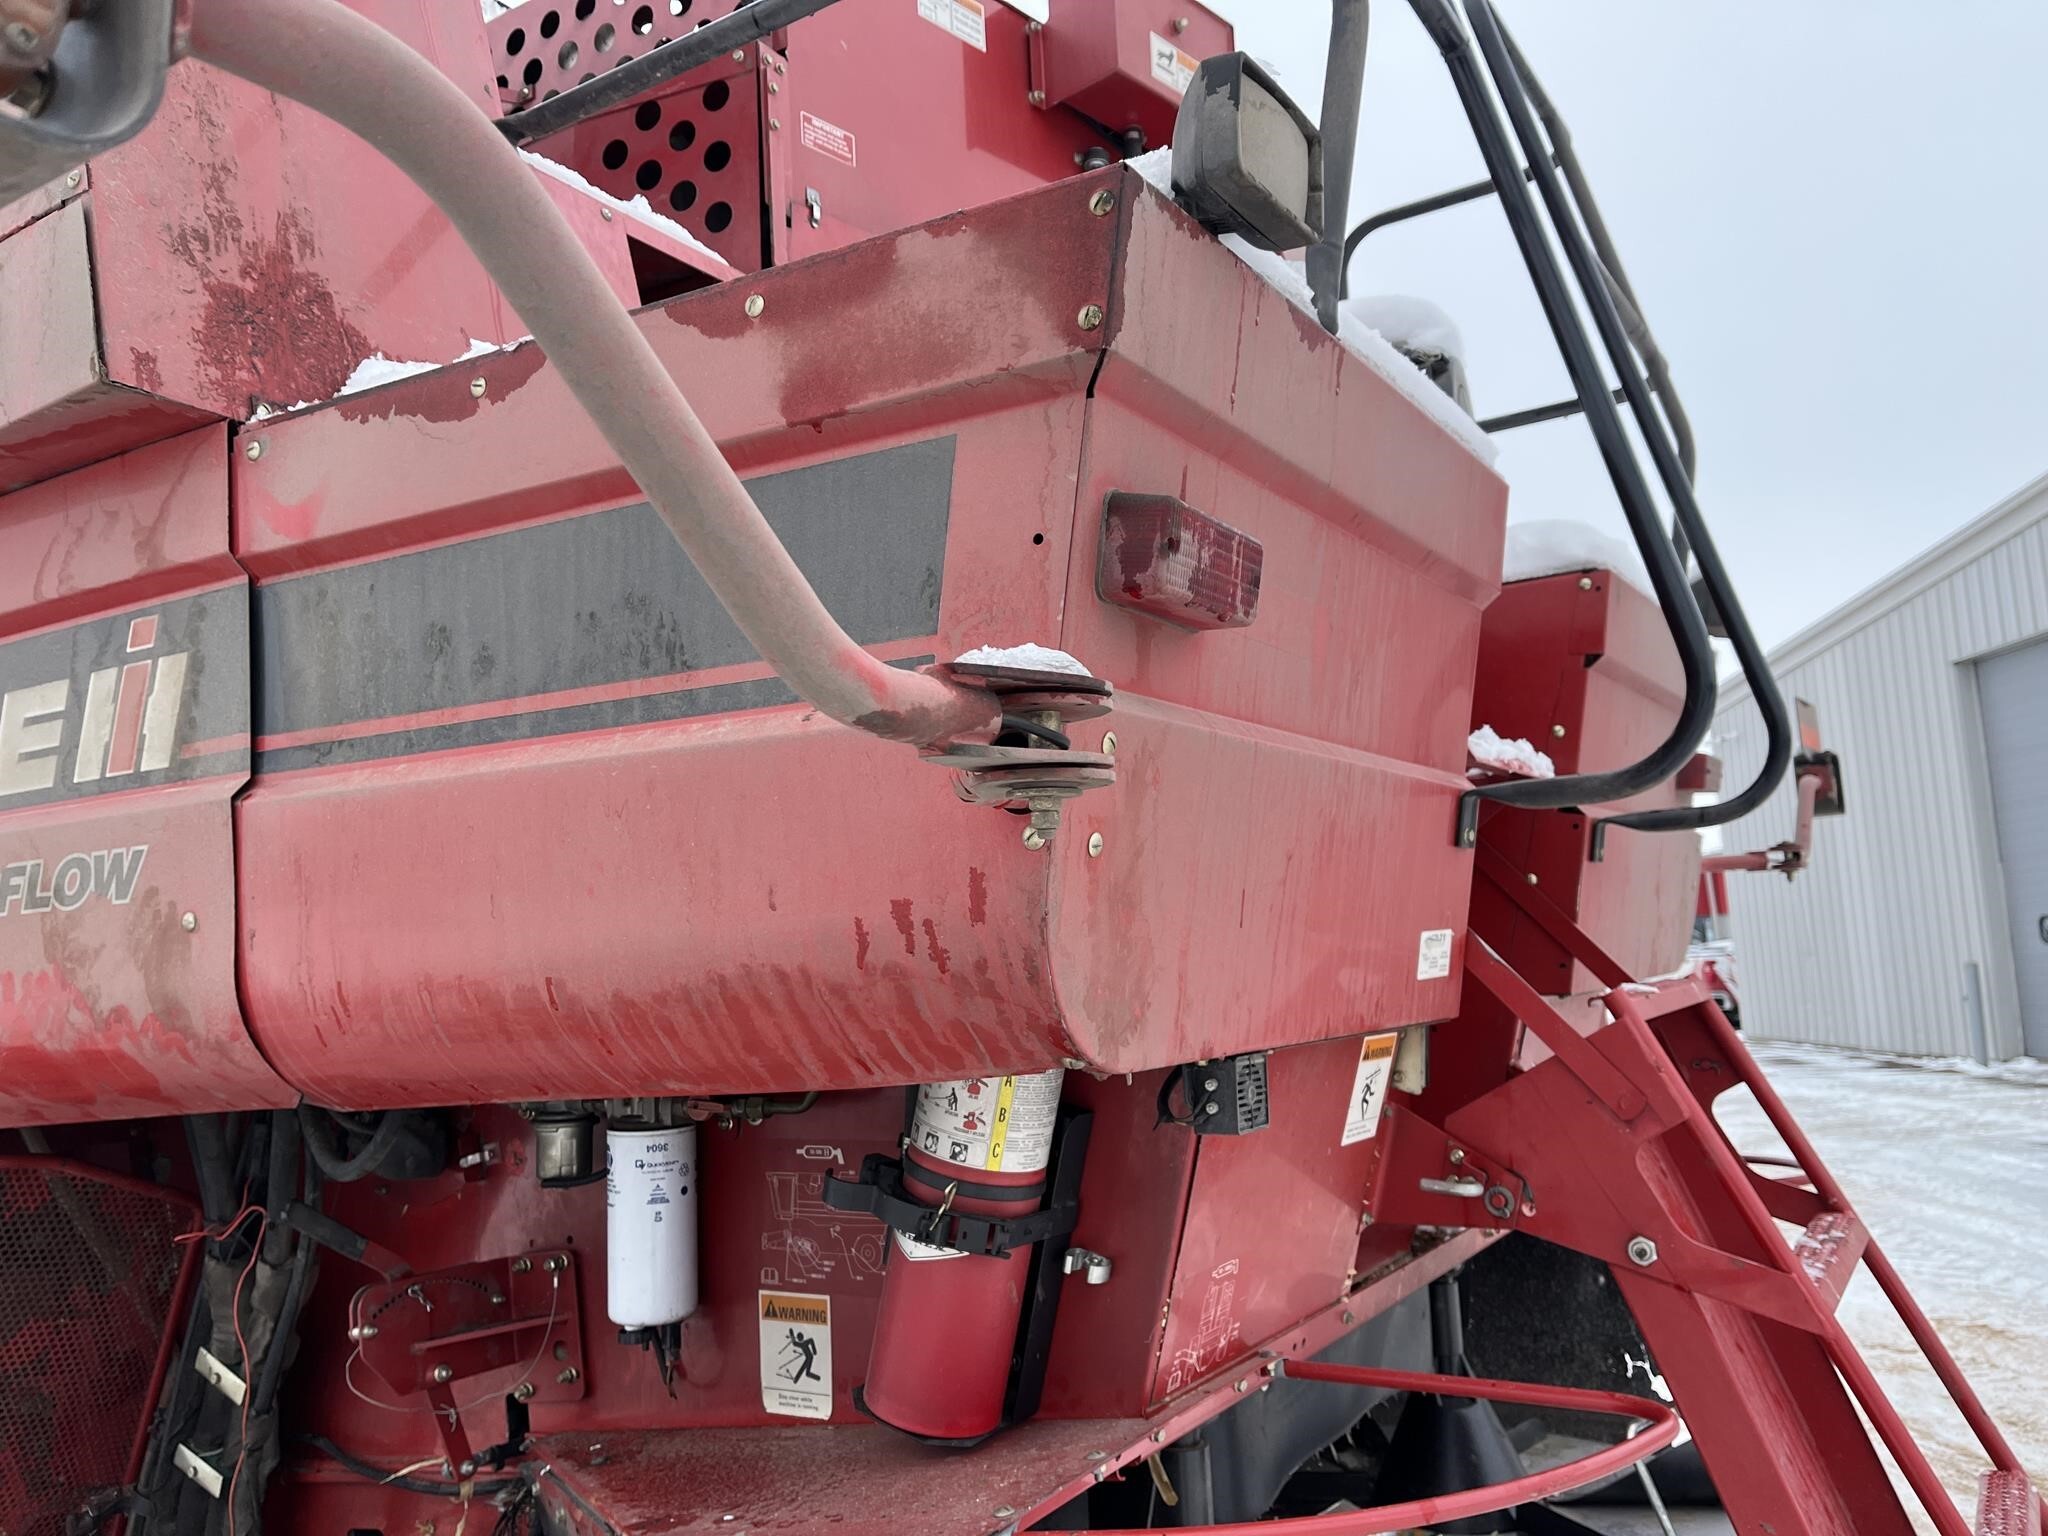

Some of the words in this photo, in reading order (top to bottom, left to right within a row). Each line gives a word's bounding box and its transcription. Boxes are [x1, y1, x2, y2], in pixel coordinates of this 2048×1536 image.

[0, 845, 149, 915] FLOW
[1004, 1075, 1012, 1087] A
[999, 1107, 1007, 1122] B
[992, 1142, 1000, 1158] C
[778, 1305, 827, 1323] WARNING
